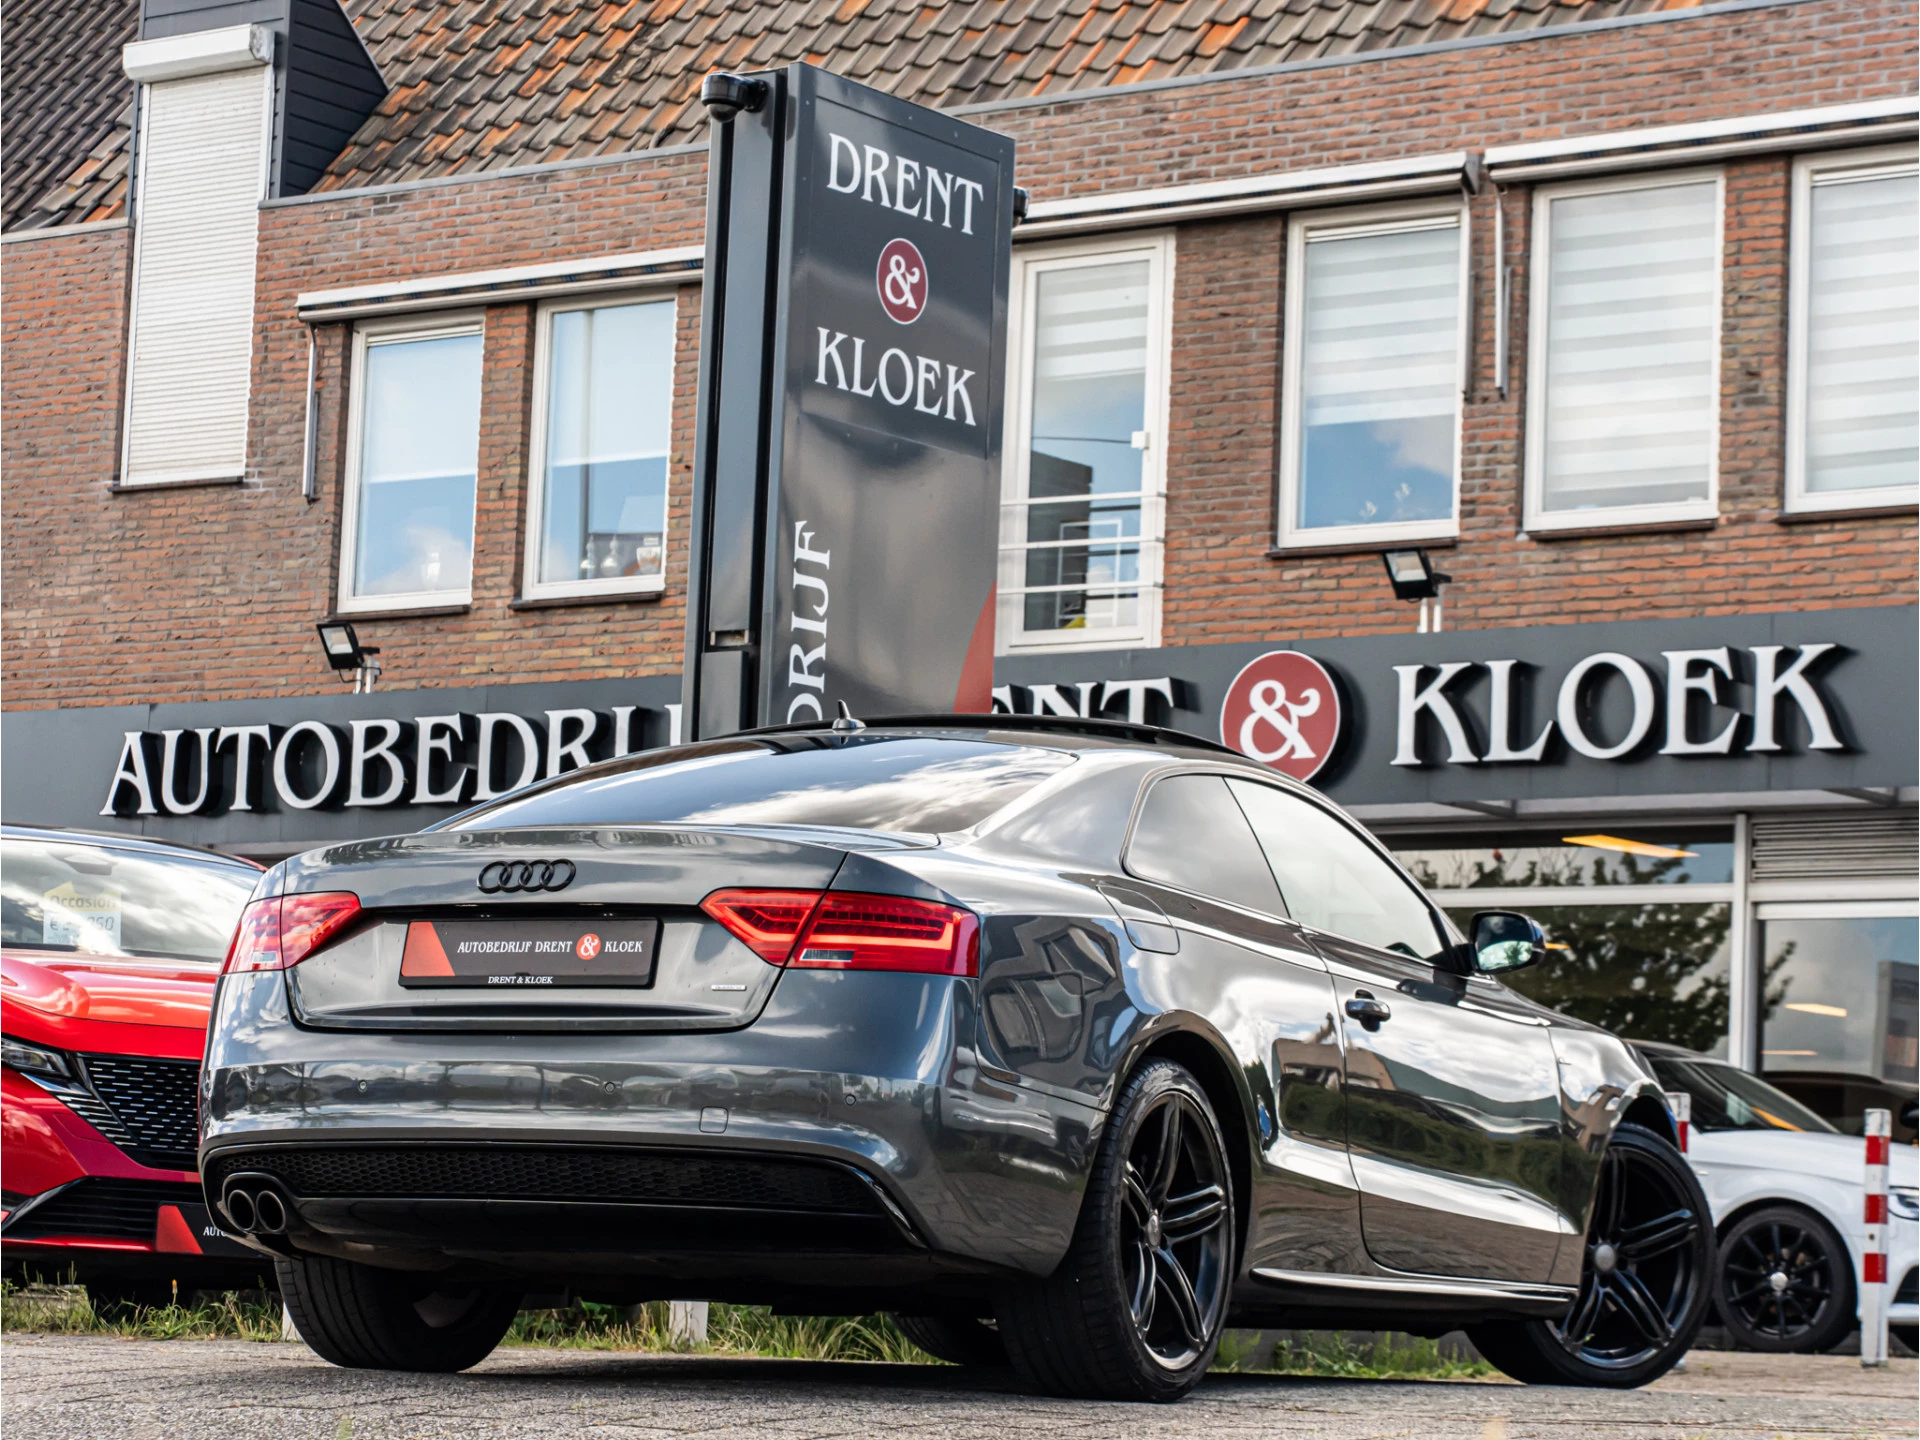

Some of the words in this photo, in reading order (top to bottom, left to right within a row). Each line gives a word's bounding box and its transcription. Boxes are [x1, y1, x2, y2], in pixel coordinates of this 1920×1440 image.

[827, 132, 984, 236] DRENT
[884, 254, 921, 310] &
[815, 326, 977, 426] KLOEK
[1239, 678, 1321, 762] &
[1390, 642, 1845, 766] KLOEK
[457, 941, 532, 953] AUTOBEDRIJF
[535, 941, 572, 953] DRENT
[580, 935, 599, 957] &
[604, 940, 643, 953] KLOEK
[488, 976, 517, 984] DRENT
[517, 976, 523, 984] &
[525, 976, 553, 984] KLOEK
